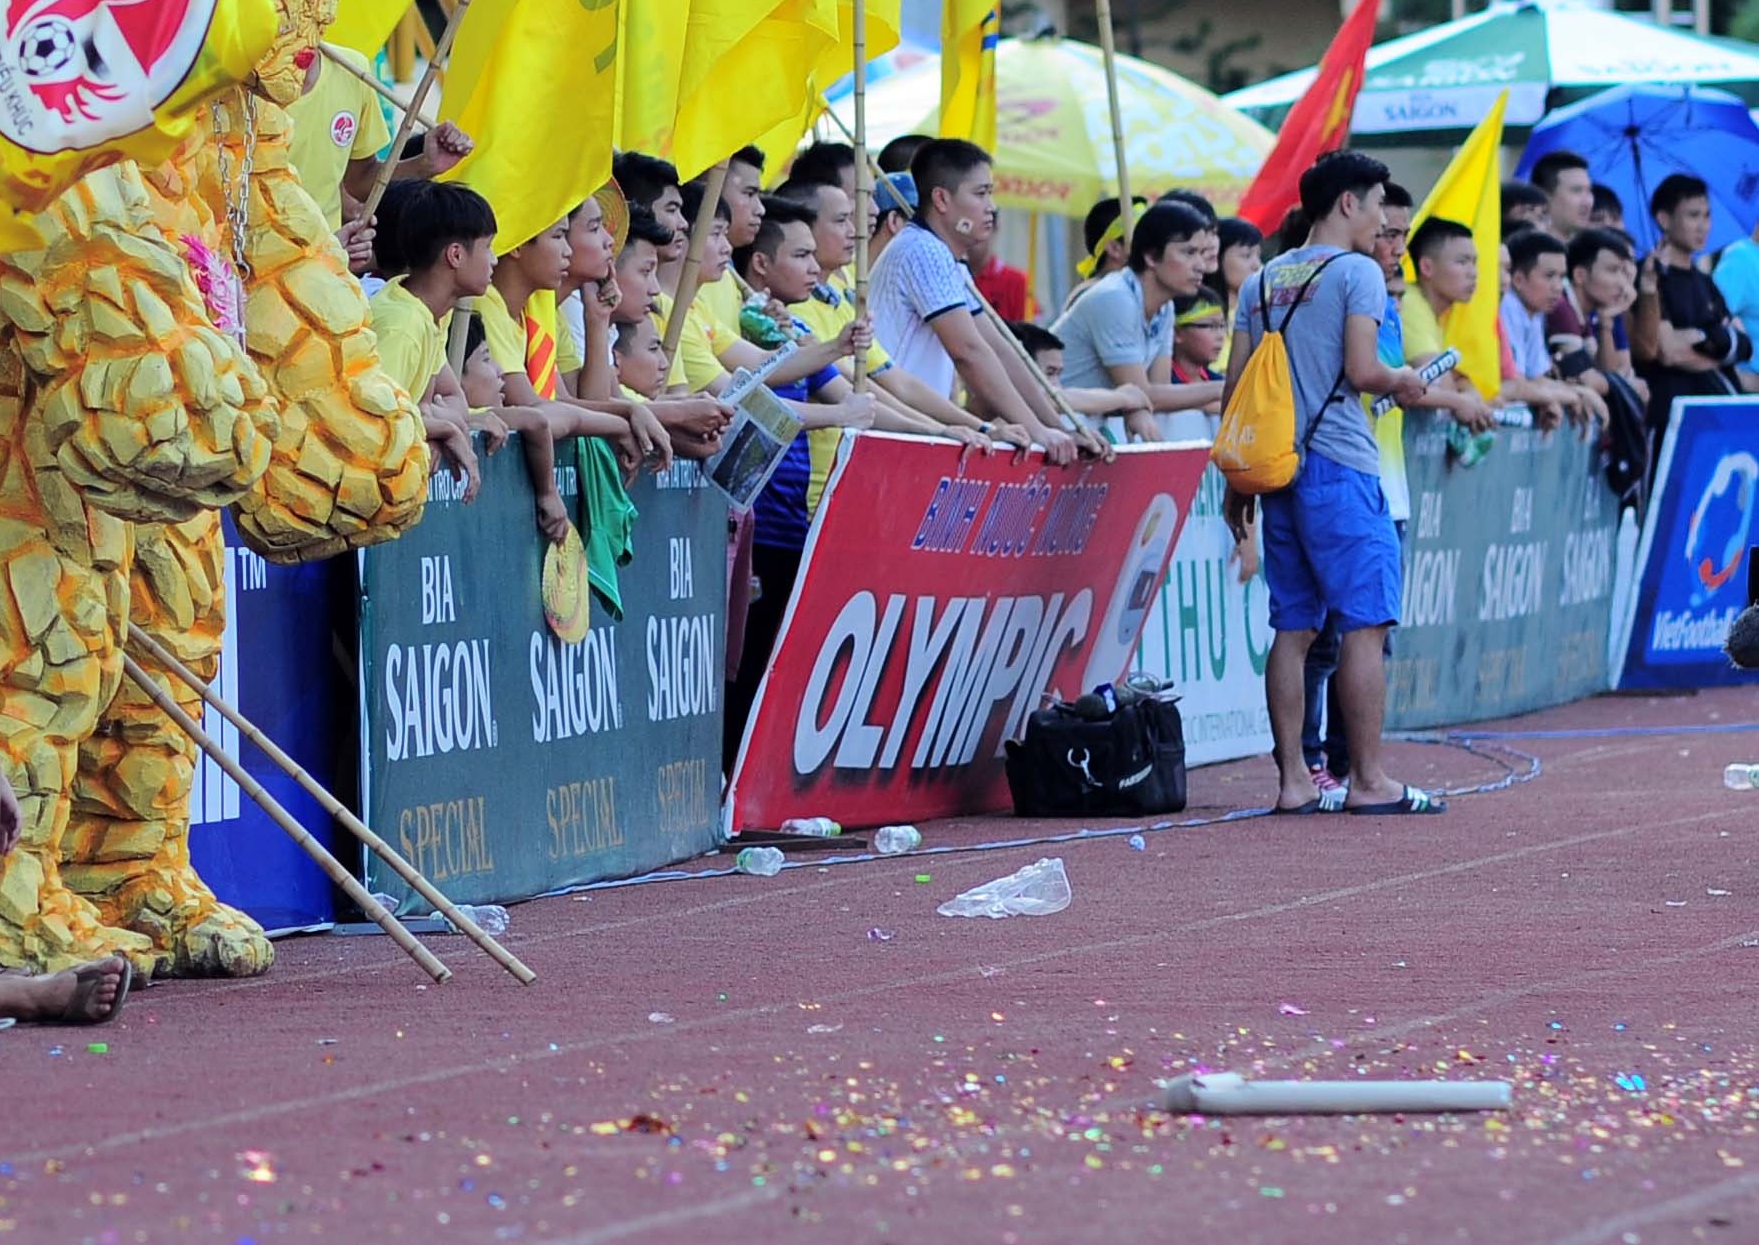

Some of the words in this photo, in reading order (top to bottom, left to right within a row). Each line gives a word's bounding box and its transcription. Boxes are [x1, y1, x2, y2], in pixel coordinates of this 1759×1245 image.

[420, 554, 456, 626] BIA
[669, 536, 693, 601] BIA
[385, 638, 495, 762] SAIGON
[529, 625, 621, 744] SAIGON
[645, 613, 716, 723] SAIGON
[397, 795, 494, 881] SPECIAL
